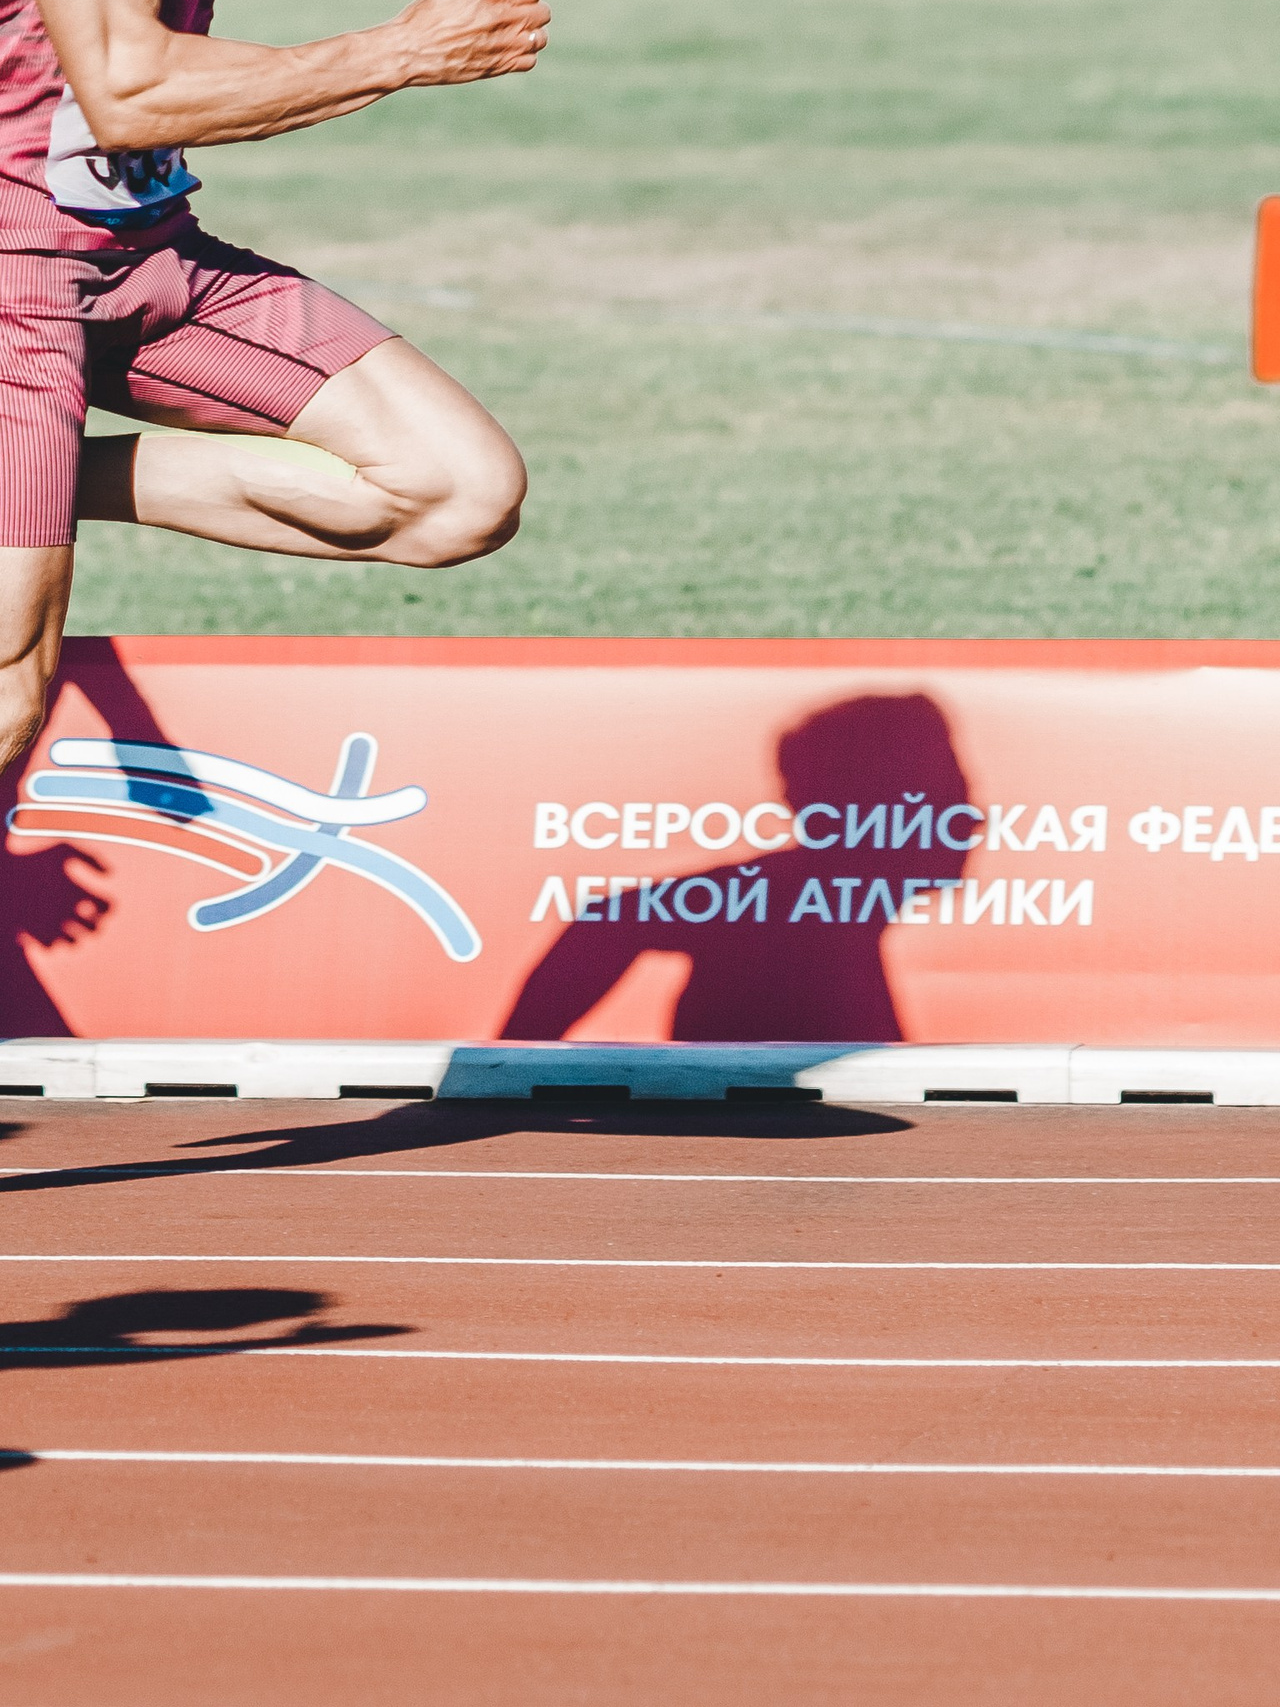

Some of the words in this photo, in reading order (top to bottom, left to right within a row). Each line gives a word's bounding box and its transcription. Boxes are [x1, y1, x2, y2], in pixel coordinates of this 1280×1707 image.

[535, 792, 1107, 852] ВСЕРОССИЙСКАЯ
[531, 866, 768, 923] ЛЕГКОЙ
[789, 877, 1093, 927] АТЛЕТИКИ
